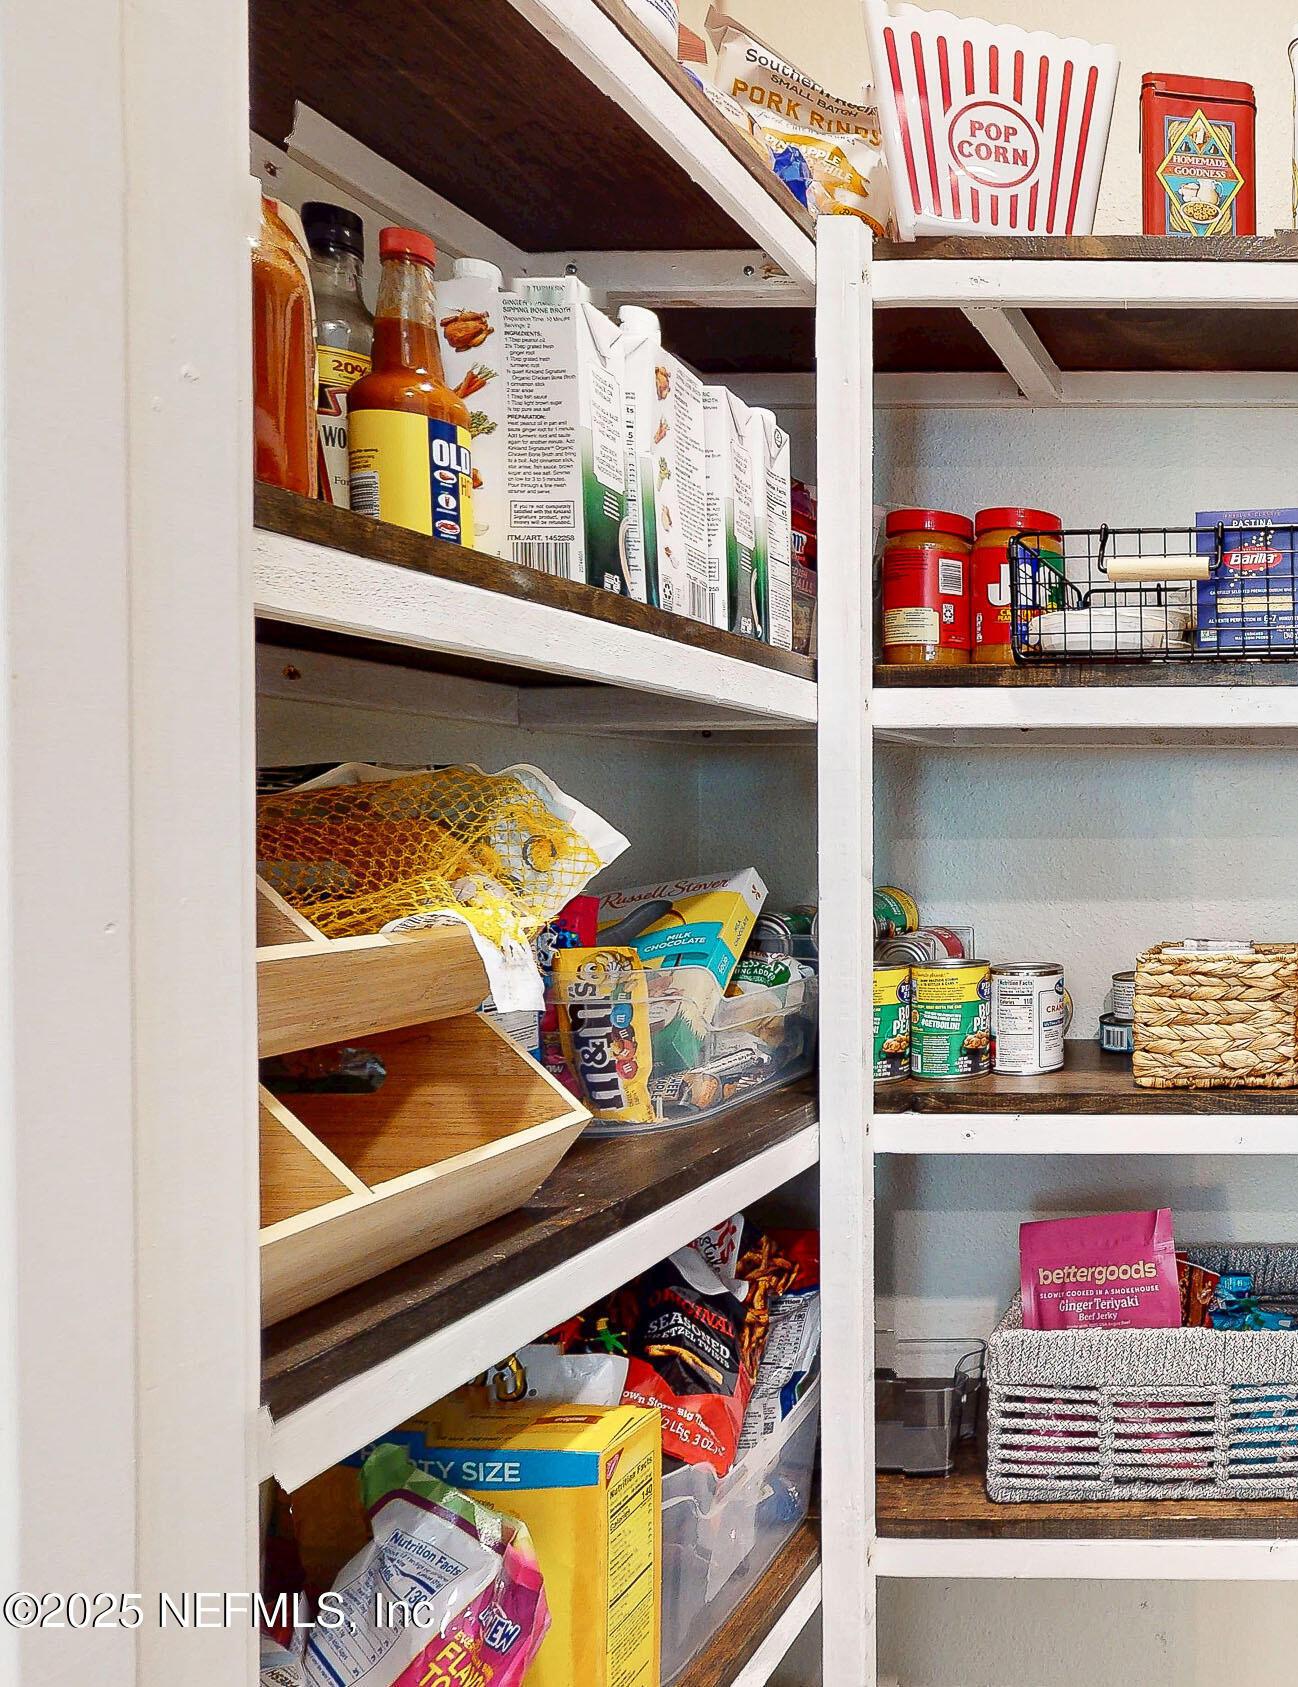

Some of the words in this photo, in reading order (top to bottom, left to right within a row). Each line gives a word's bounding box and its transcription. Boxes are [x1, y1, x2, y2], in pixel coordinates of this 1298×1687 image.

[731, 77, 801, 121] PORK
[771, 74, 814, 102] SMALL
[817, 98, 858, 118] BATCH
[969, 120, 1017, 143] POP
[958, 140, 1028, 167] CORN
[1173, 155, 1228, 167] HOMEMADE
[1174, 167, 1226, 178] GOODNESS
[432, 438, 471, 477] OLD
[1232, 519, 1273, 528] PASTINA
[1229, 553, 1276, 565] Barilla
[600, 884, 668, 909] Russell
[668, 878, 729, 897] Stover
[644, 936, 706, 953] CHOCOLATE
[666, 931, 692, 941] MILK
[1039, 1260, 1158, 1285] bettergoods
[1039, 1292, 1065, 1300] SLOWLY
[1066, 1289, 1094, 1297] COOKED
[1095, 1288, 1103, 1296] IN
[1111, 1284, 1159, 1295] SMOKEHOUSE
[648, 1288, 735, 1338] ORIGINAL
[1059, 1300, 1092, 1313] Ginger
[1094, 1295, 1139, 1310] Teriyaki
[1078, 1313, 1095, 1321] Beef
[1096, 1312, 1118, 1321] Jerky
[648, 1312, 730, 1359] SEASONED
[462, 1461, 521, 1483] SIZE
[390, 1531, 437, 1562] Nutrition
[435, 1554, 462, 1576] Facts
